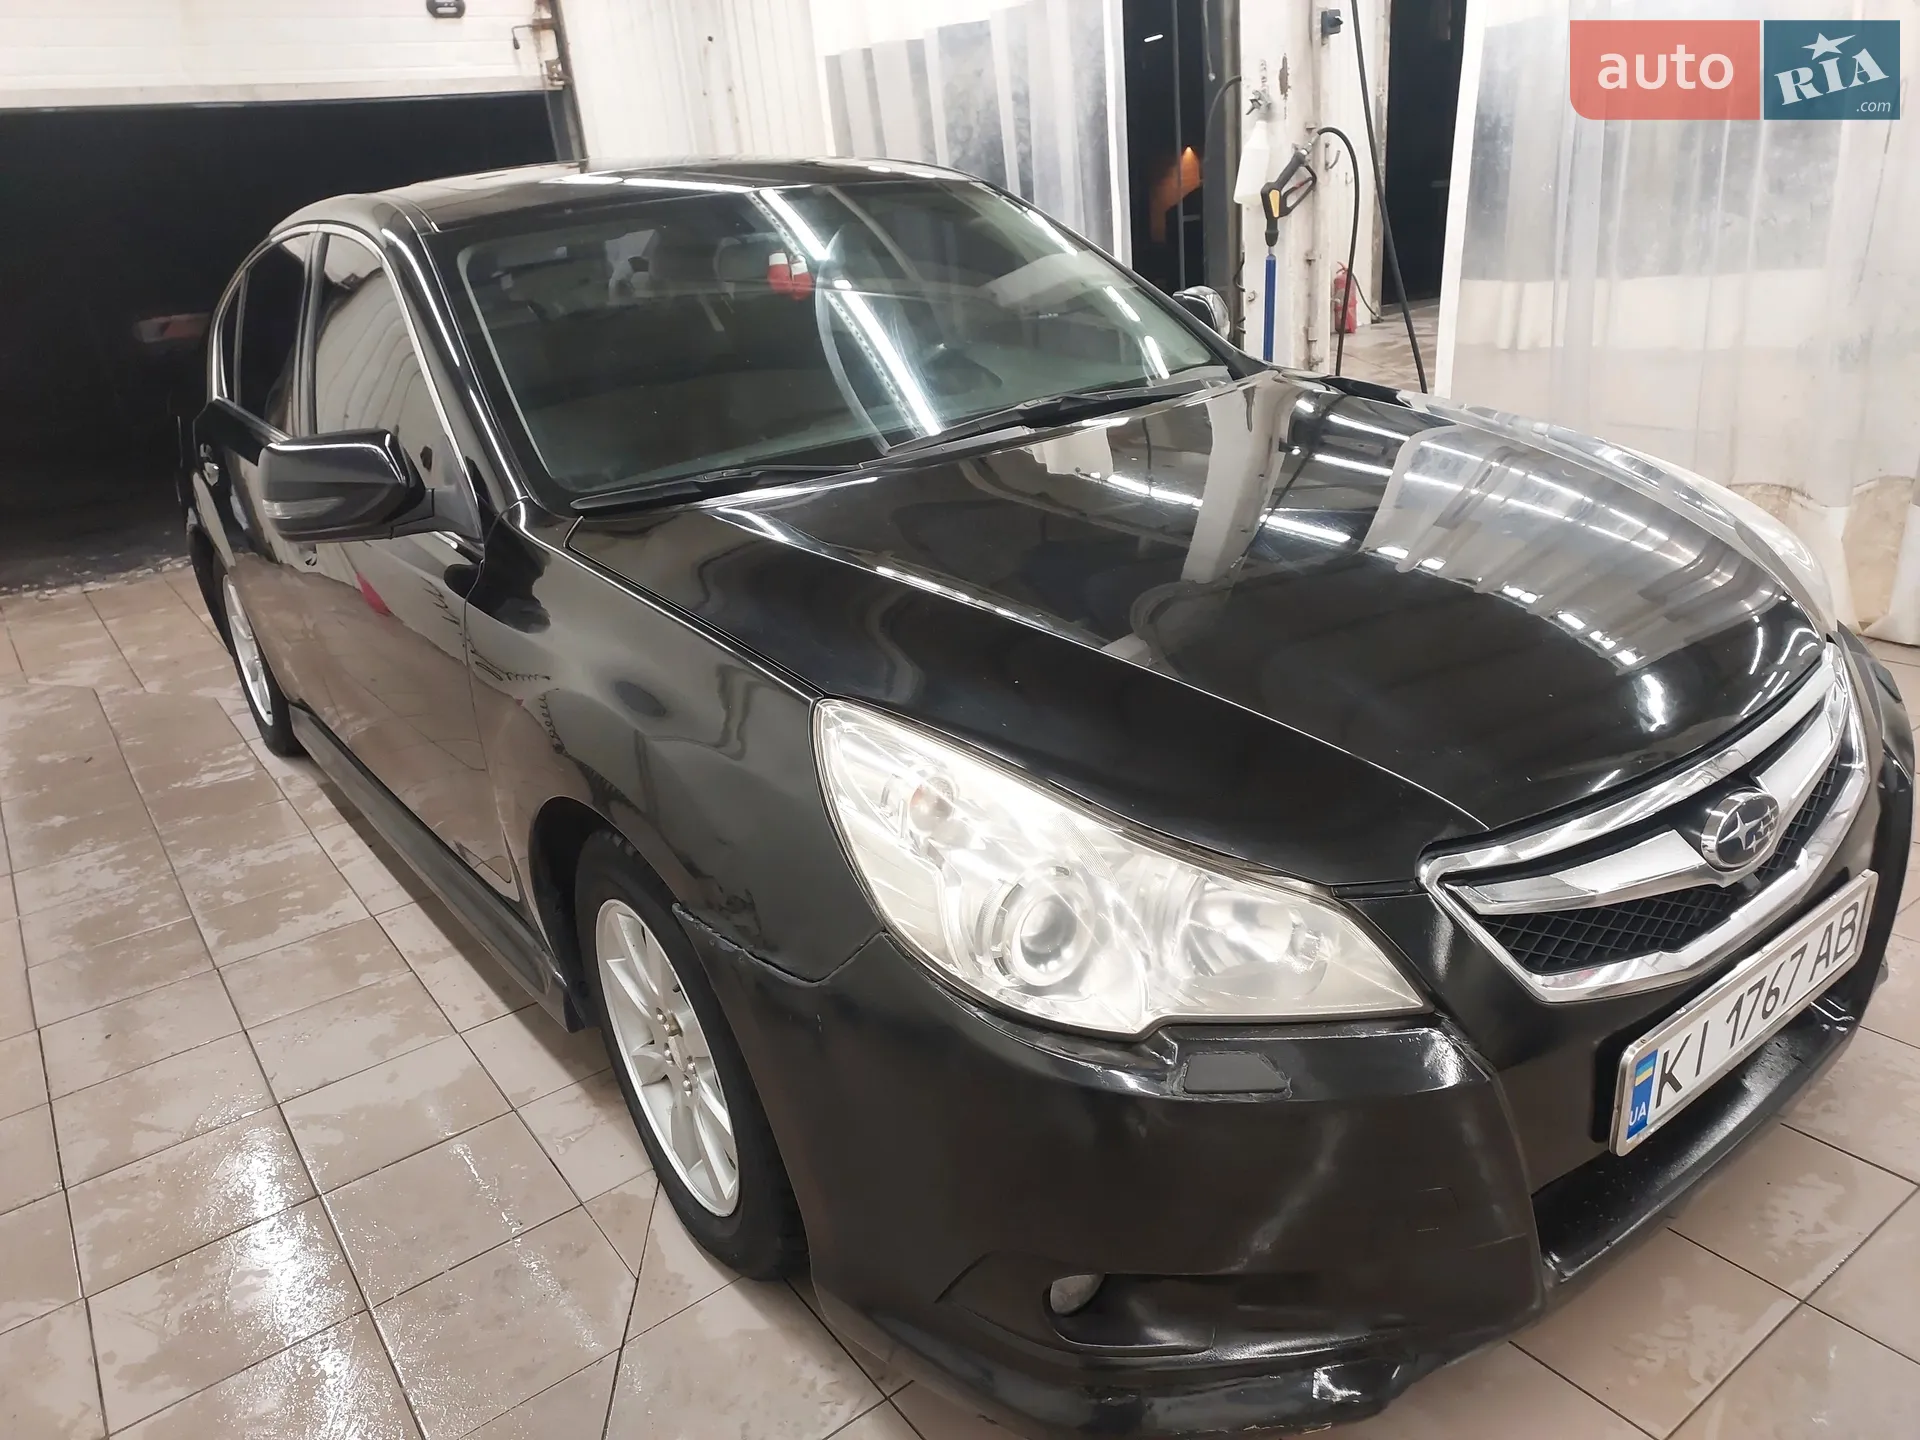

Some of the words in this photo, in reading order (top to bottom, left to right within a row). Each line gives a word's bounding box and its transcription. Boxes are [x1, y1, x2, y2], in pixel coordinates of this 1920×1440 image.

[1655, 1020, 1709, 1108] KI
[1725, 943, 1808, 1049] 1767
[1809, 901, 1859, 983] AB
[1629, 1106, 1647, 1126] UA
